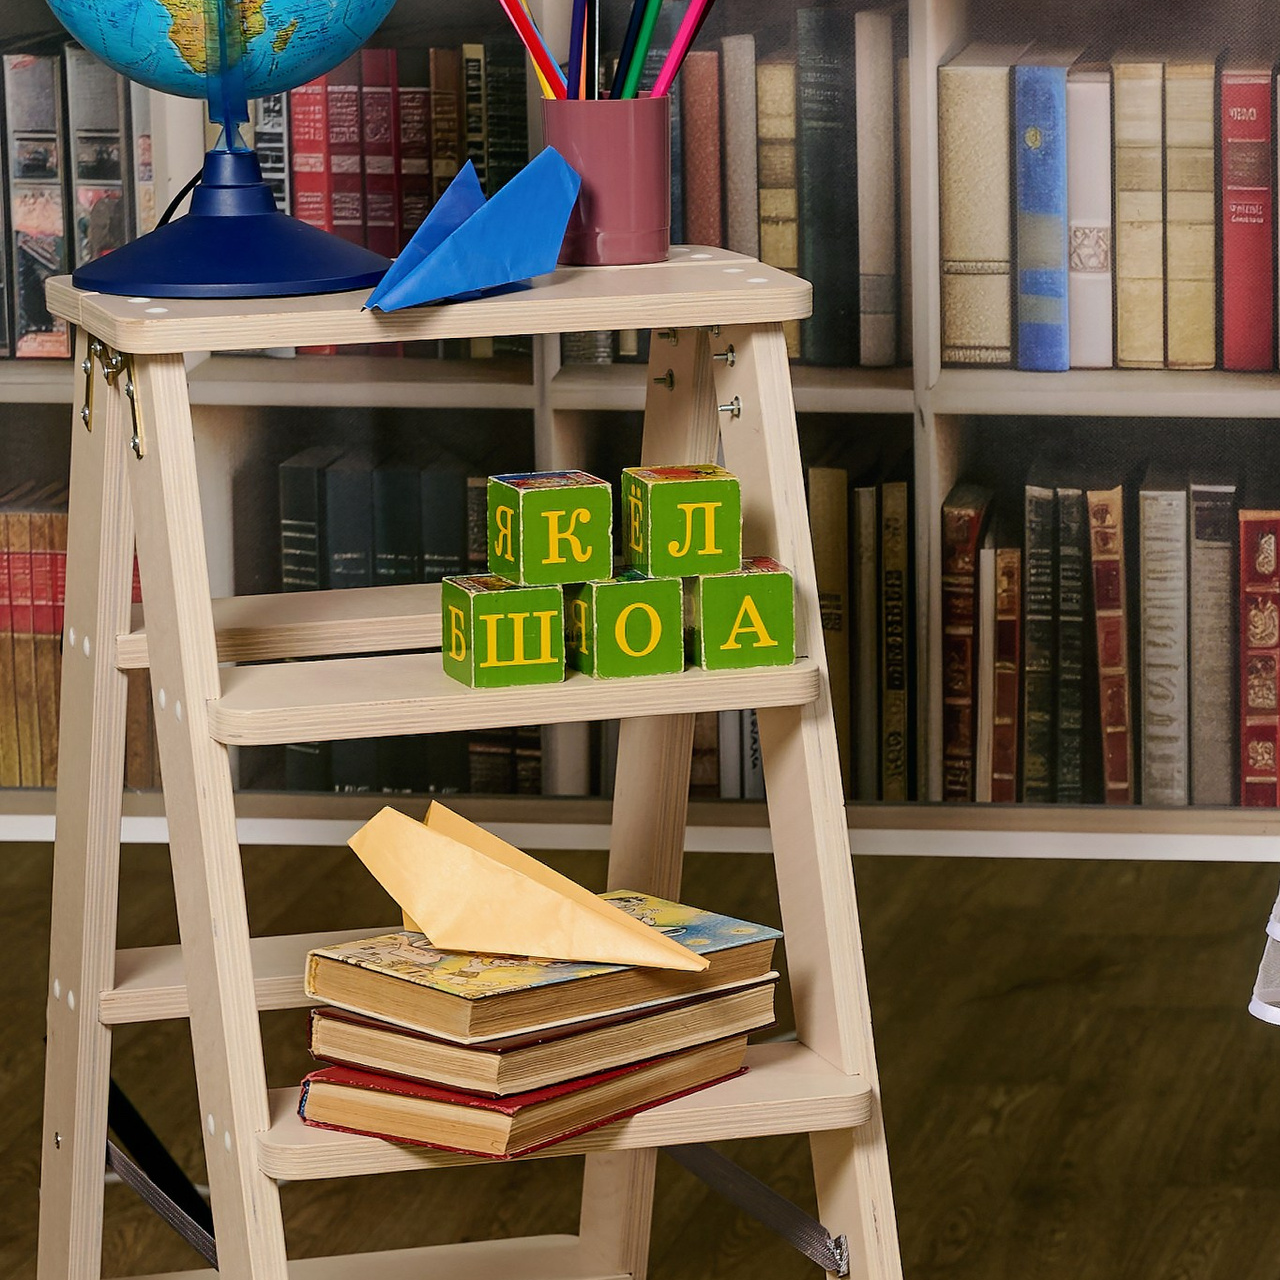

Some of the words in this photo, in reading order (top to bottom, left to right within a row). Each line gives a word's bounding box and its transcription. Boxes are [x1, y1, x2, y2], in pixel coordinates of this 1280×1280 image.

[494, 505, 514, 562] Я
[541, 508, 592, 564] К
[667, 502, 722, 557] Л
[448, 605, 467, 662] Б
[479, 610, 558, 668] Ш
[614, 603, 662, 657] О
[720, 595, 778, 650] А
